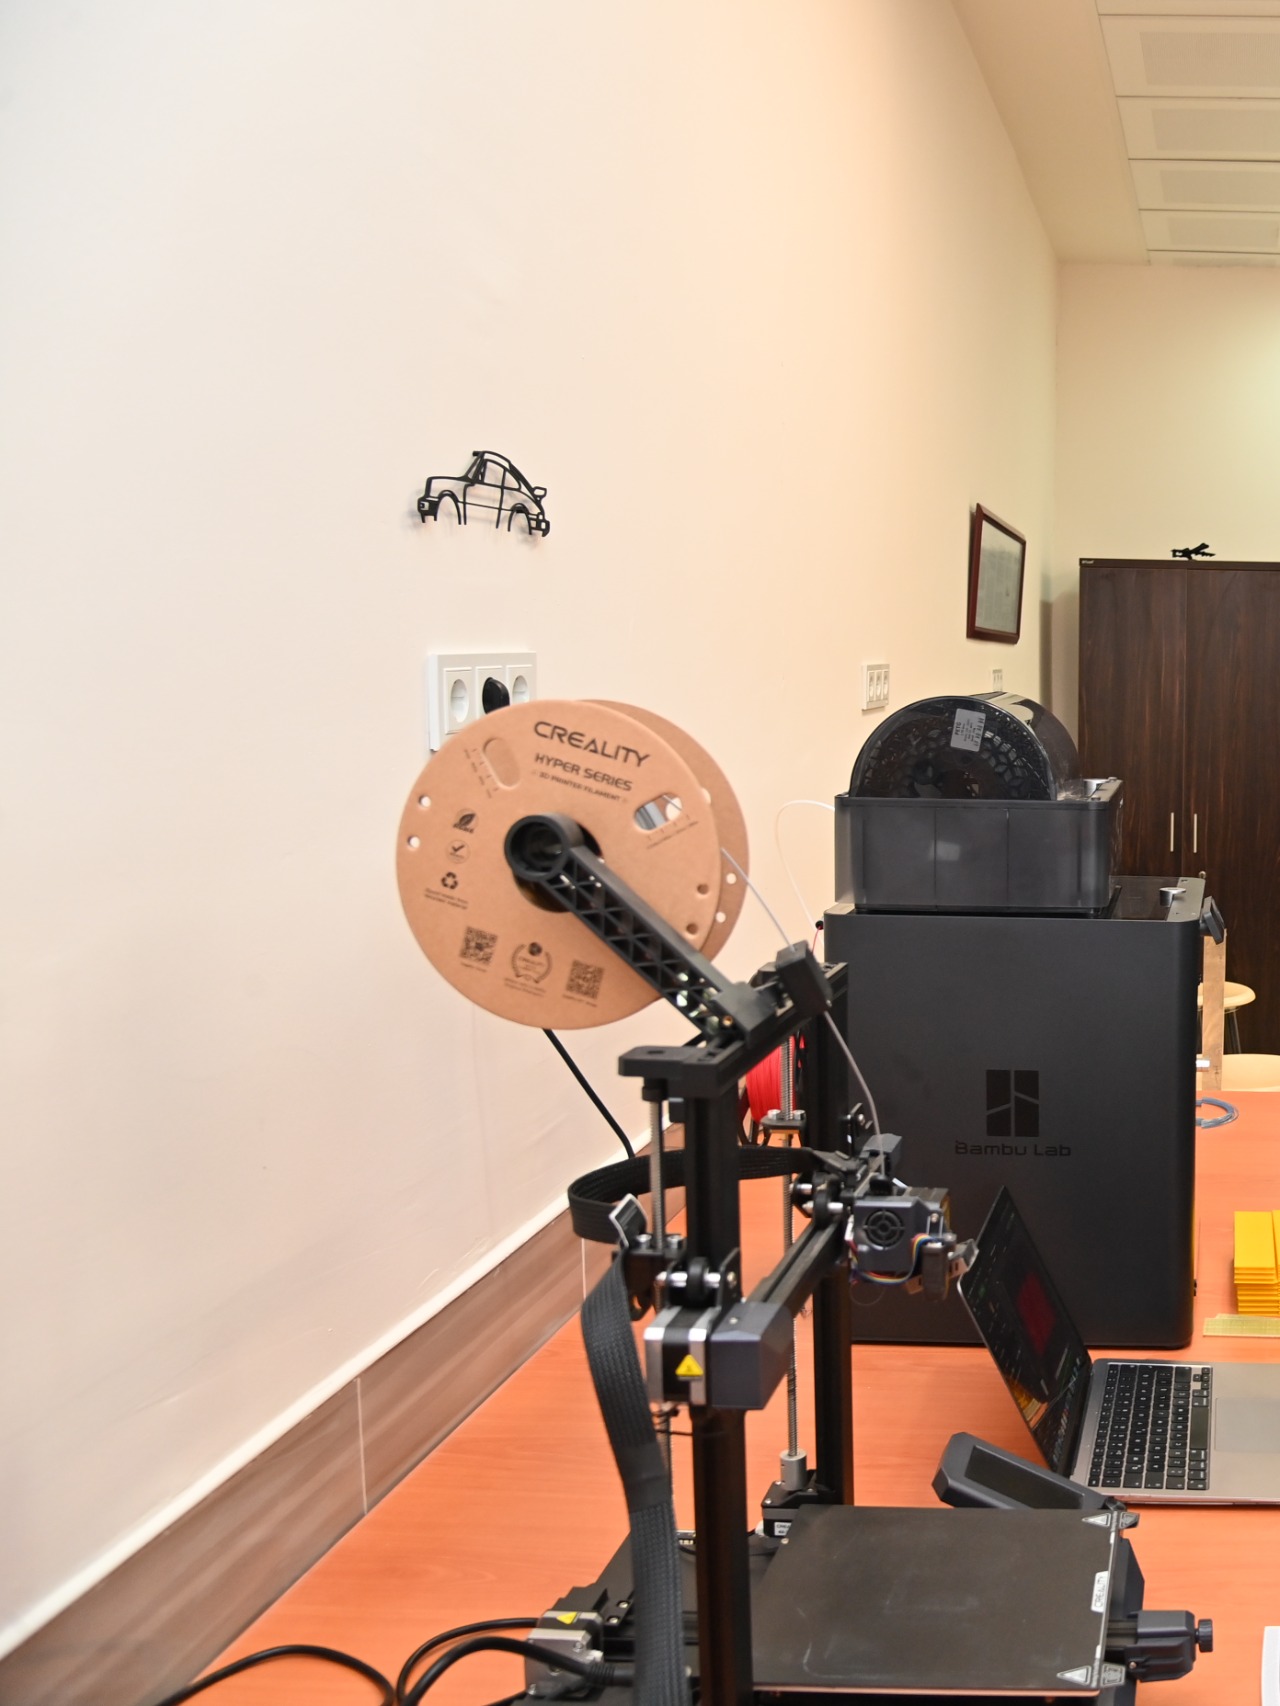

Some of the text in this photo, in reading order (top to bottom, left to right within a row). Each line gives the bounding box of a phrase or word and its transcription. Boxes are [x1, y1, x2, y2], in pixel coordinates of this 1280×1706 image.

[534, 721, 650, 767] CREALITY
[534, 752, 633, 792] HYPER SERIES
[539, 771, 621, 801] 3D PRINTER FILAMENT
[954, 1140, 1071, 1157] Bambu Lab
